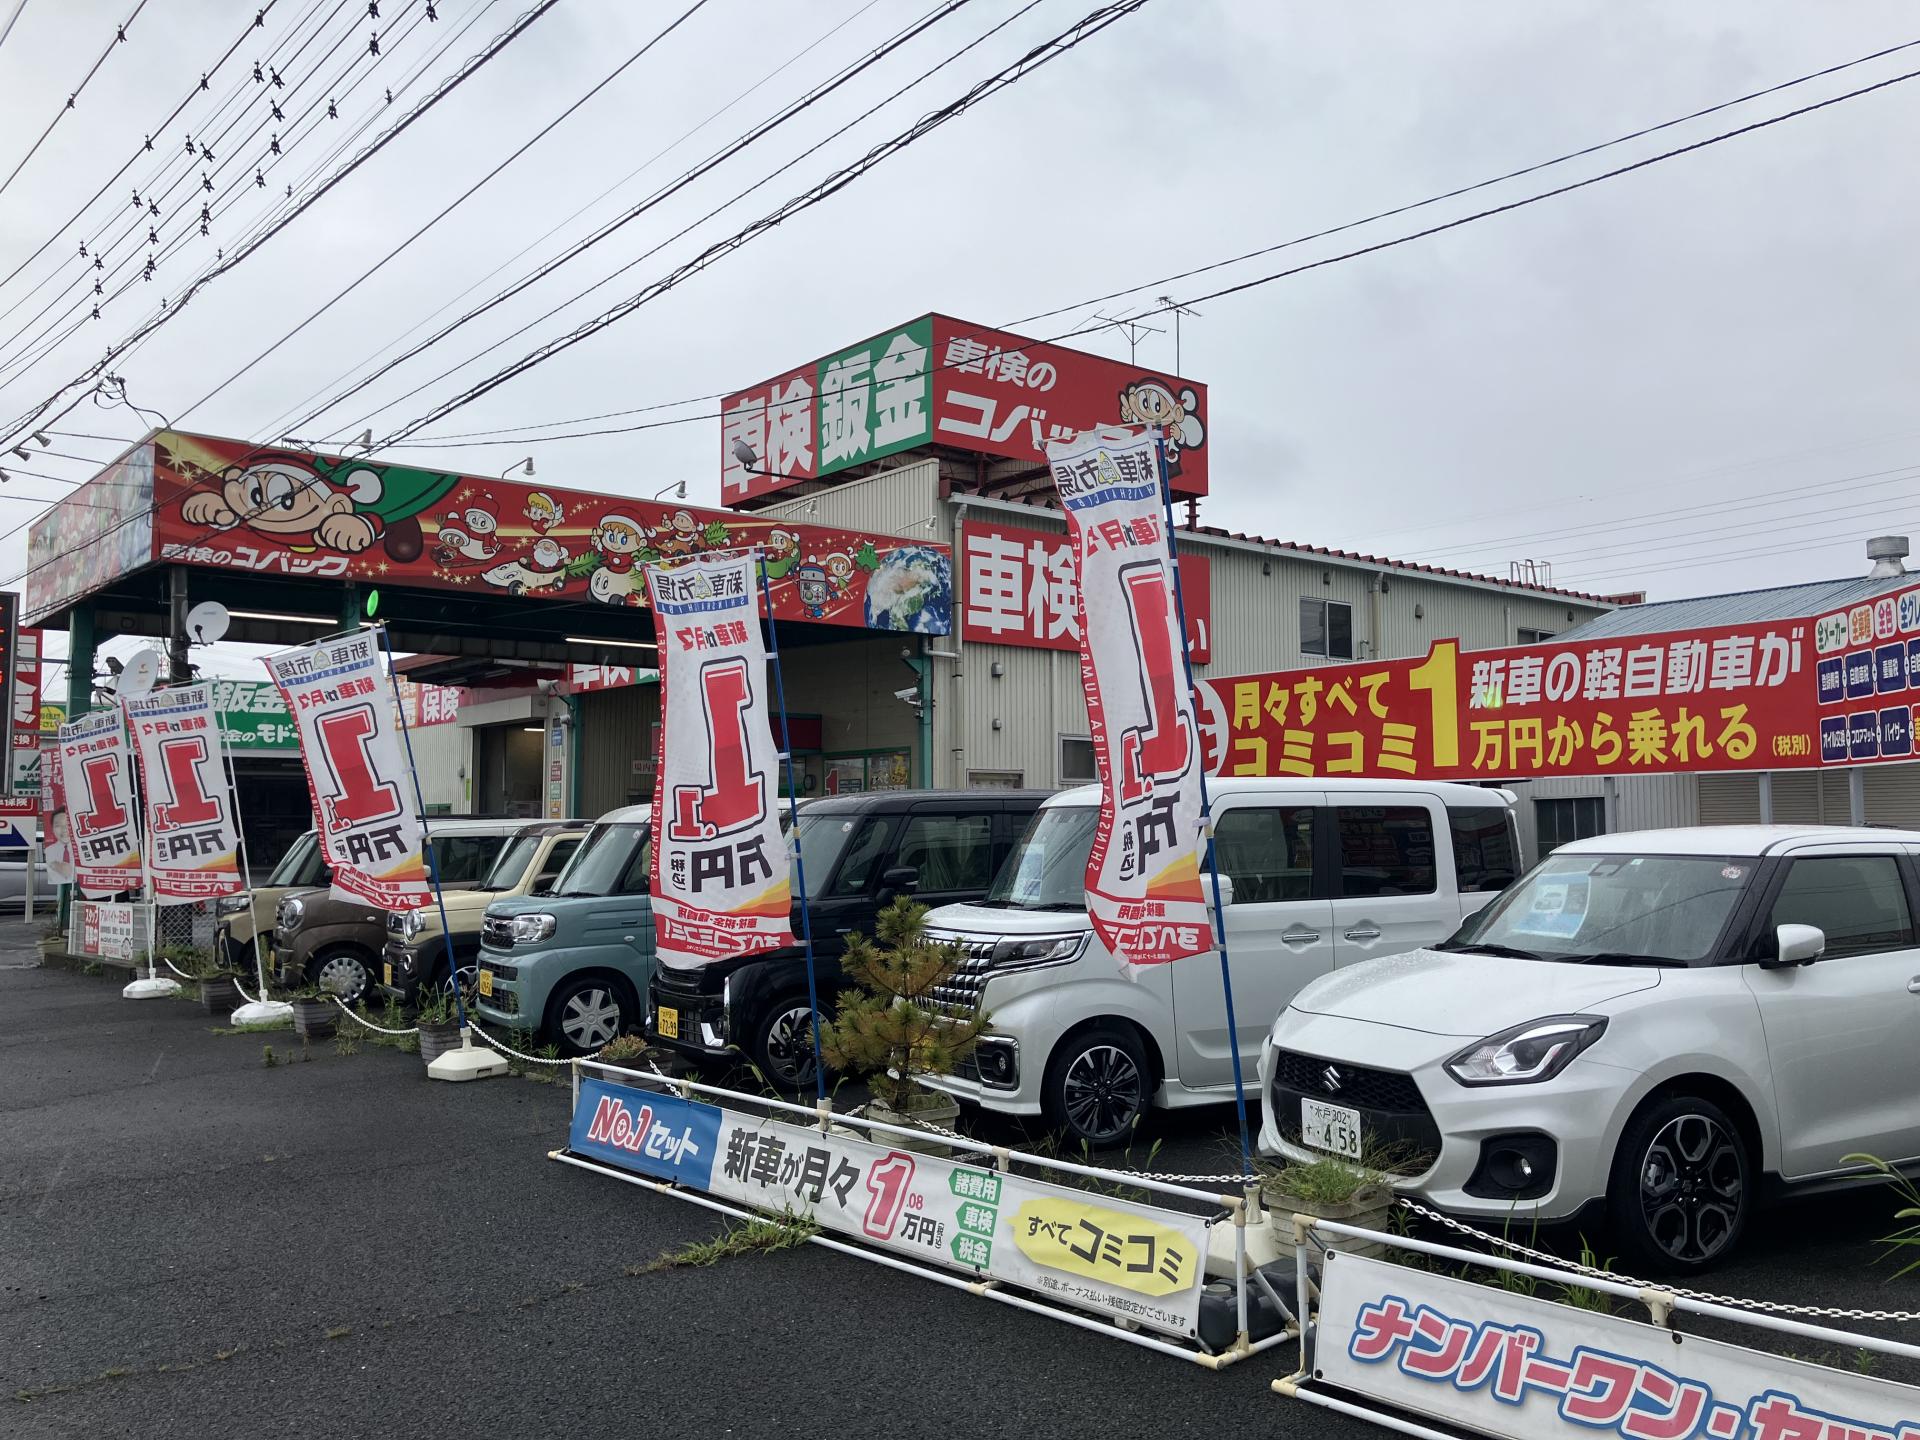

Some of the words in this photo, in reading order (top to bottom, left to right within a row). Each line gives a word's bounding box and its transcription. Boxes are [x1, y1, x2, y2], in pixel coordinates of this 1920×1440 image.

[943, 336, 1057, 392] 車検の
[724, 376, 813, 494] 車検
[821, 333, 927, 467] 鈑金
[968, 533, 1080, 641] 車検
[1817, 617, 1847, 650] 全メーカー
[1879, 601, 1893, 635] 全色
[1469, 627, 1804, 709] 新車の軽自動車が
[422, 687, 460, 723] 保険
[1233, 671, 1390, 731] 月々すべて
[1409, 642, 1459, 767] 1
[1233, 723, 1417, 777] コミコミ
[1470, 703, 1757, 770] 万円から乗れる
[1772, 733, 1812, 757] (税別)
[1884, 722, 1905, 742] バイザー
[724, 1127, 860, 1208] 新車が月々
[900, 1212, 937, 1246] 万円
[955, 1171, 998, 1201] 諸費用
[964, 1206, 993, 1233] 車検
[958, 1237, 988, 1265] 税金
[1028, 1216, 1183, 1285] すべてコミコミ
